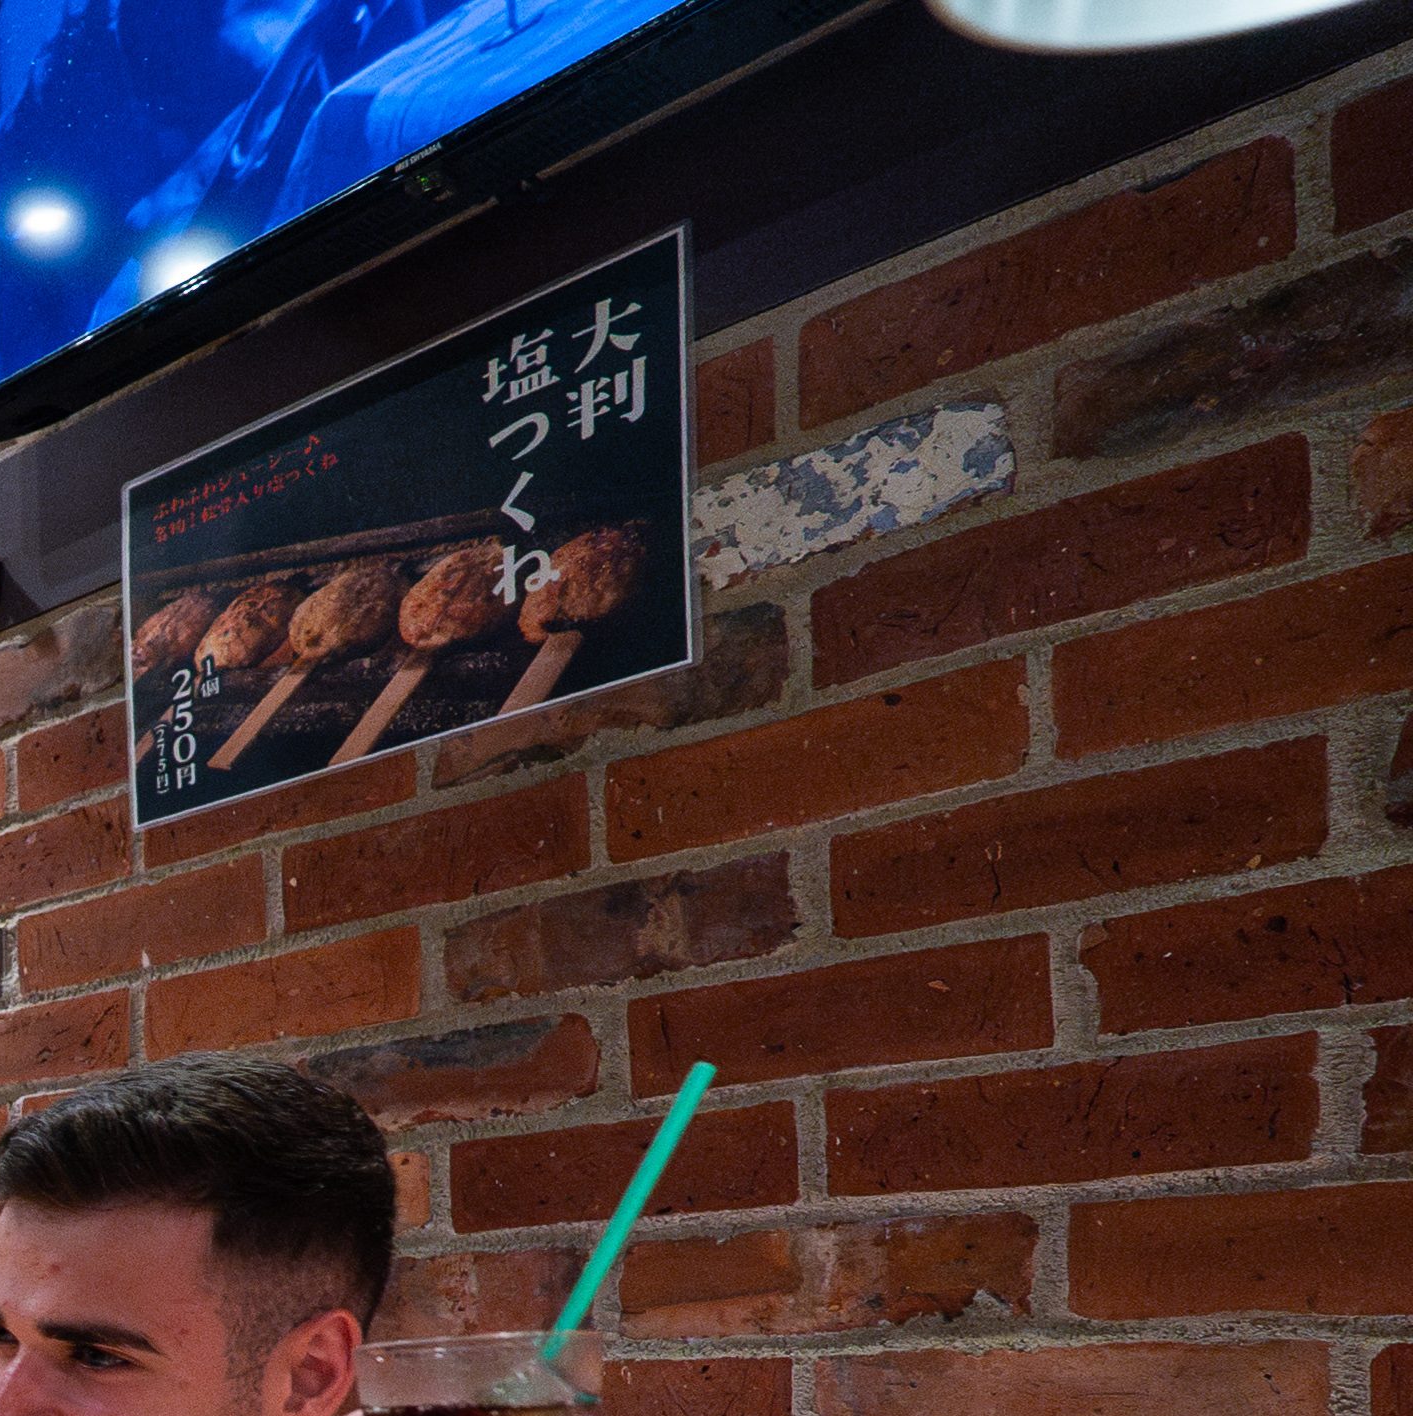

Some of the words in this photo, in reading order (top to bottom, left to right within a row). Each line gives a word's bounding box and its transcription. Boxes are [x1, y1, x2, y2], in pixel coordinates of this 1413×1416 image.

[566, 297, 647, 440] 大判
[481, 327, 561, 606] 塩つくね
[171, 668, 196, 790] 250円
[200, 658, 220, 698] 1個
[154, 723, 170, 794] (275円)
